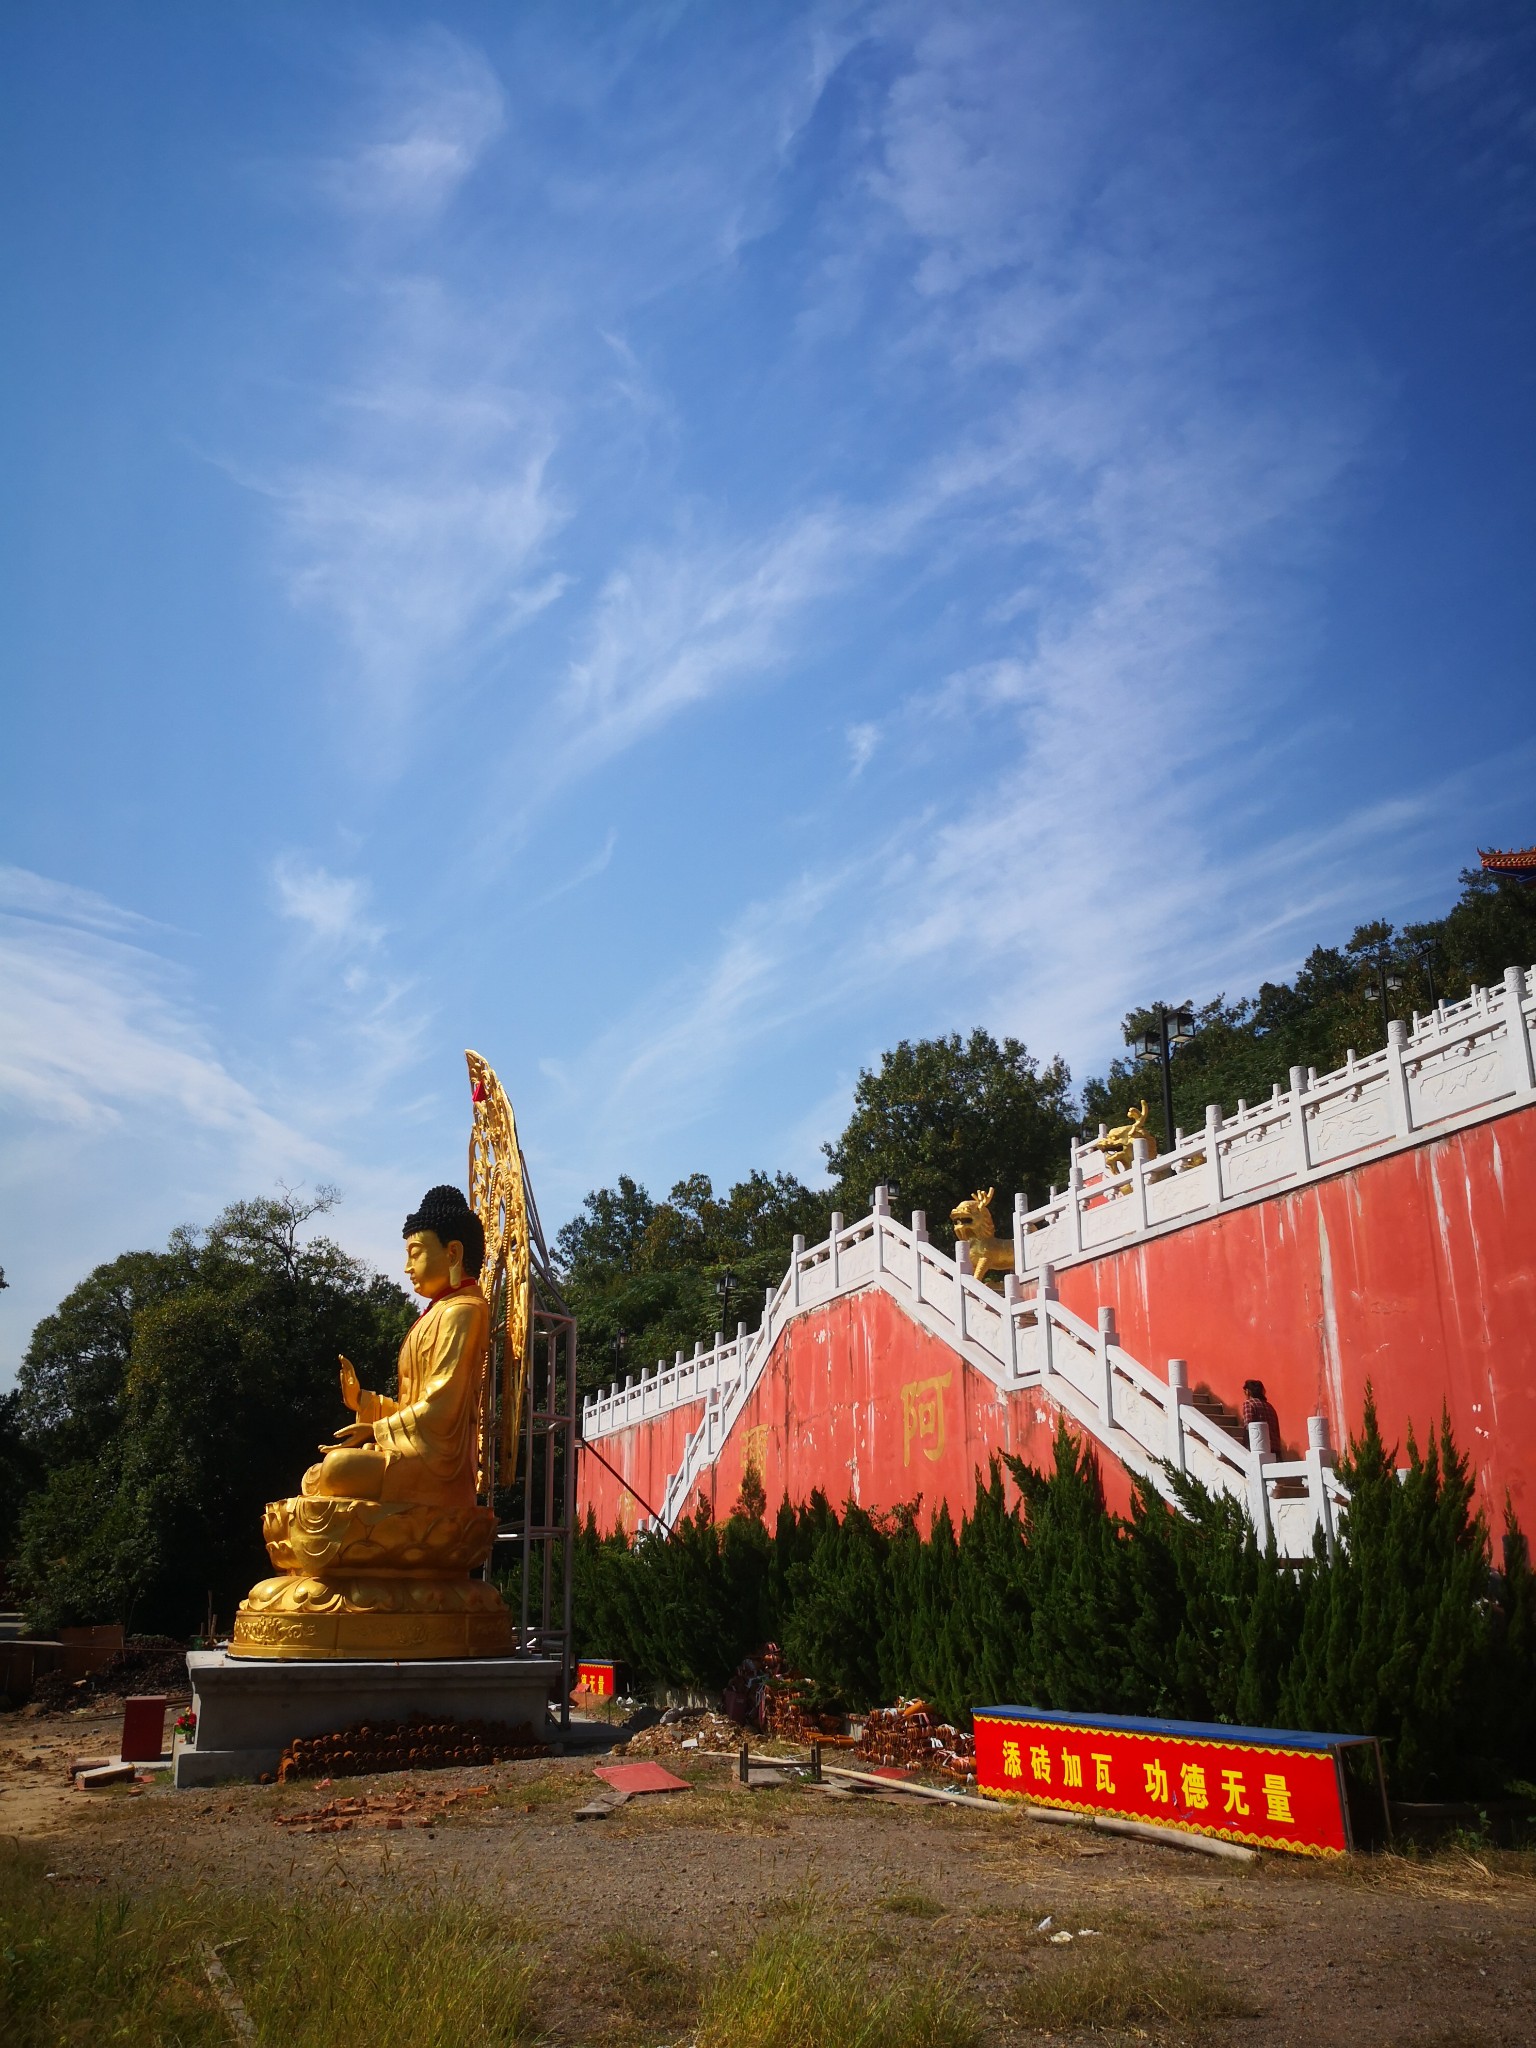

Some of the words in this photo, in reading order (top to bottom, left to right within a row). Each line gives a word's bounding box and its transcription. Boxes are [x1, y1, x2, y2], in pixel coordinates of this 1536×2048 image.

[900, 1370, 952, 1467] 阿
[1002, 1740, 1116, 1794] 添砖加瓦
[1143, 1758, 1295, 1823] 功德无量
